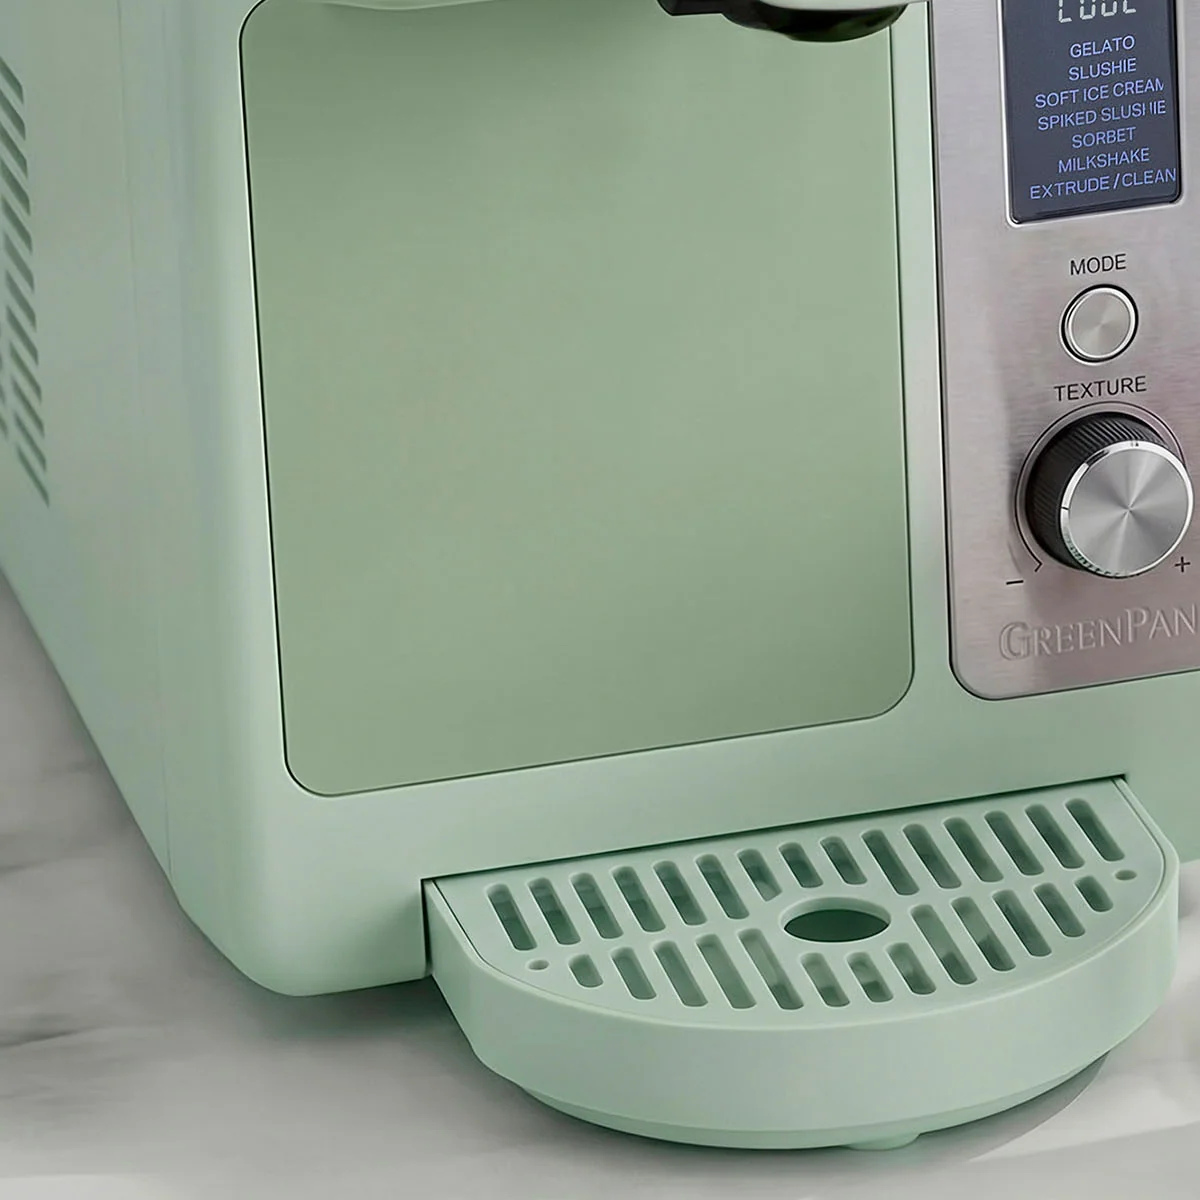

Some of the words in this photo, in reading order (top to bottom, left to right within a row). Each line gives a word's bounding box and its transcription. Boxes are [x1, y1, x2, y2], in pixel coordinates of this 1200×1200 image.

[1069, 35, 1135, 58] GELATO
[1068, 57, 1136, 81] SLUSHIE
[1035, 89, 1079, 109] SOFT
[1083, 84, 1109, 102] ICE
[1037, 111, 1097, 131] SPIKED
[1071, 126, 1137, 149] SORBET
[1058, 148, 1150, 173] MILKSHAKE
[1070, 254, 1127, 275] MODE
[1054, 375, 1147, 402] TEXTURE
